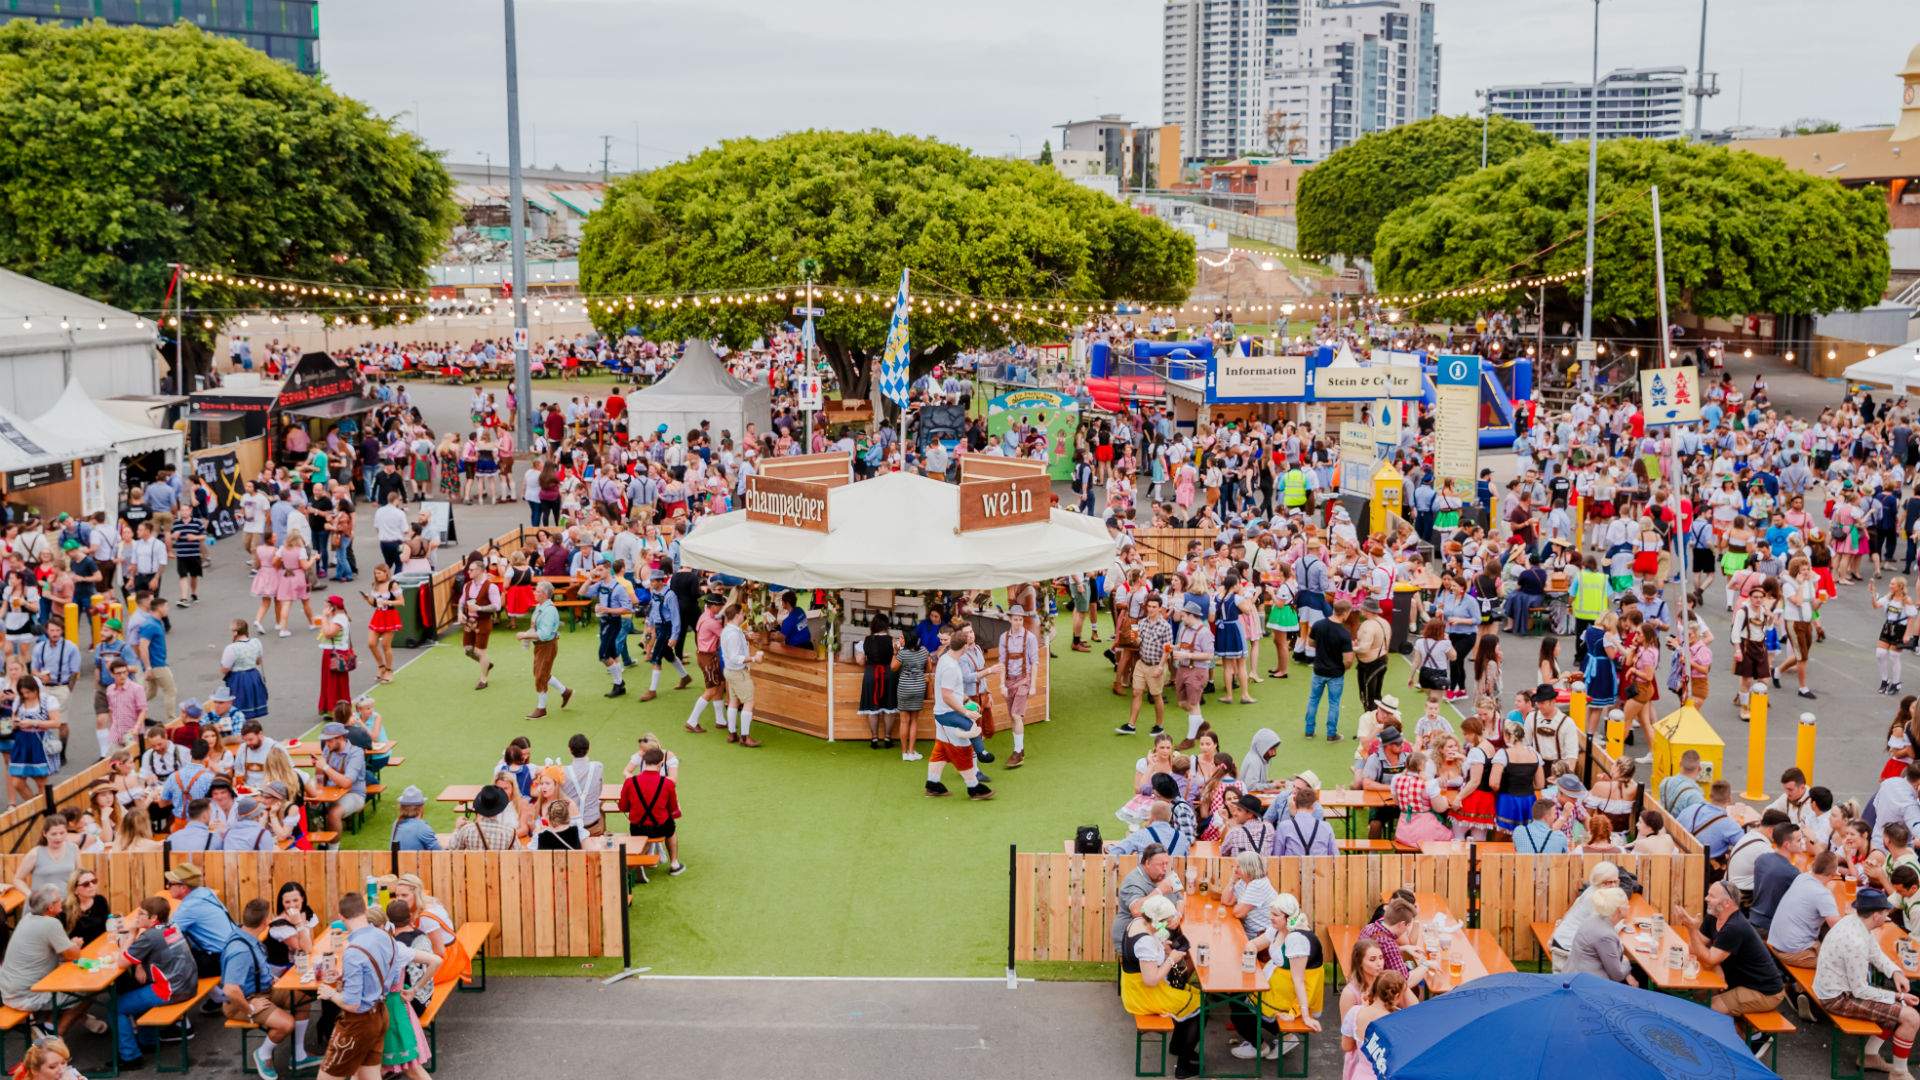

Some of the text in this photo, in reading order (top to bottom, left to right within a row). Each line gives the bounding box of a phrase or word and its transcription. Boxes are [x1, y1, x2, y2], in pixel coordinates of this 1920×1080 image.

[1225, 366, 1297, 376] Information
[1328, 377, 1408, 386] Stein & Coler
[745, 479, 825, 527] champagner
[982, 482, 1033, 518] wein
